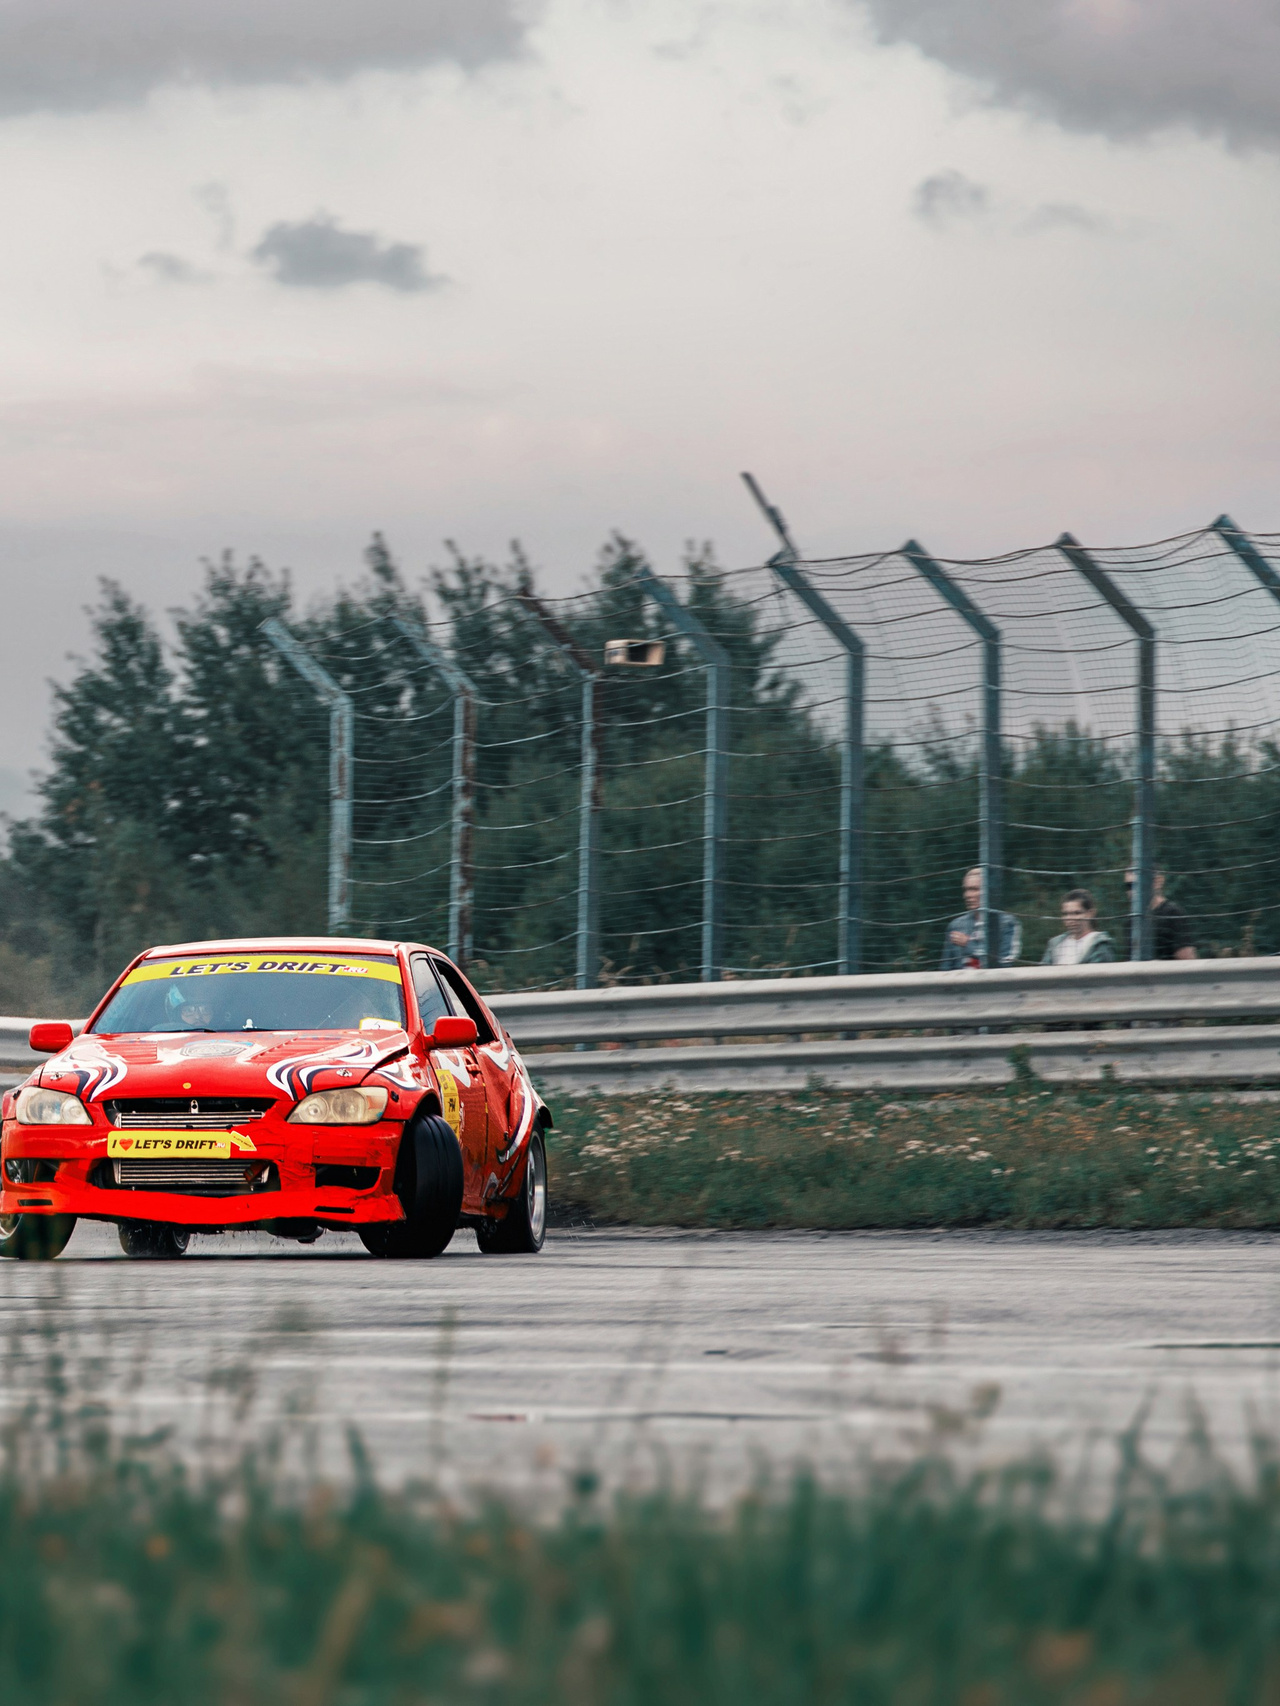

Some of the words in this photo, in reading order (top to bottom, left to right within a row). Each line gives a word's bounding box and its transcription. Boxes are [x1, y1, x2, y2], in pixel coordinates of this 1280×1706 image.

[169, 961, 251, 977] LET'S
[111, 1139, 118, 1149] I
[134, 1139, 172, 1149] LET'S
